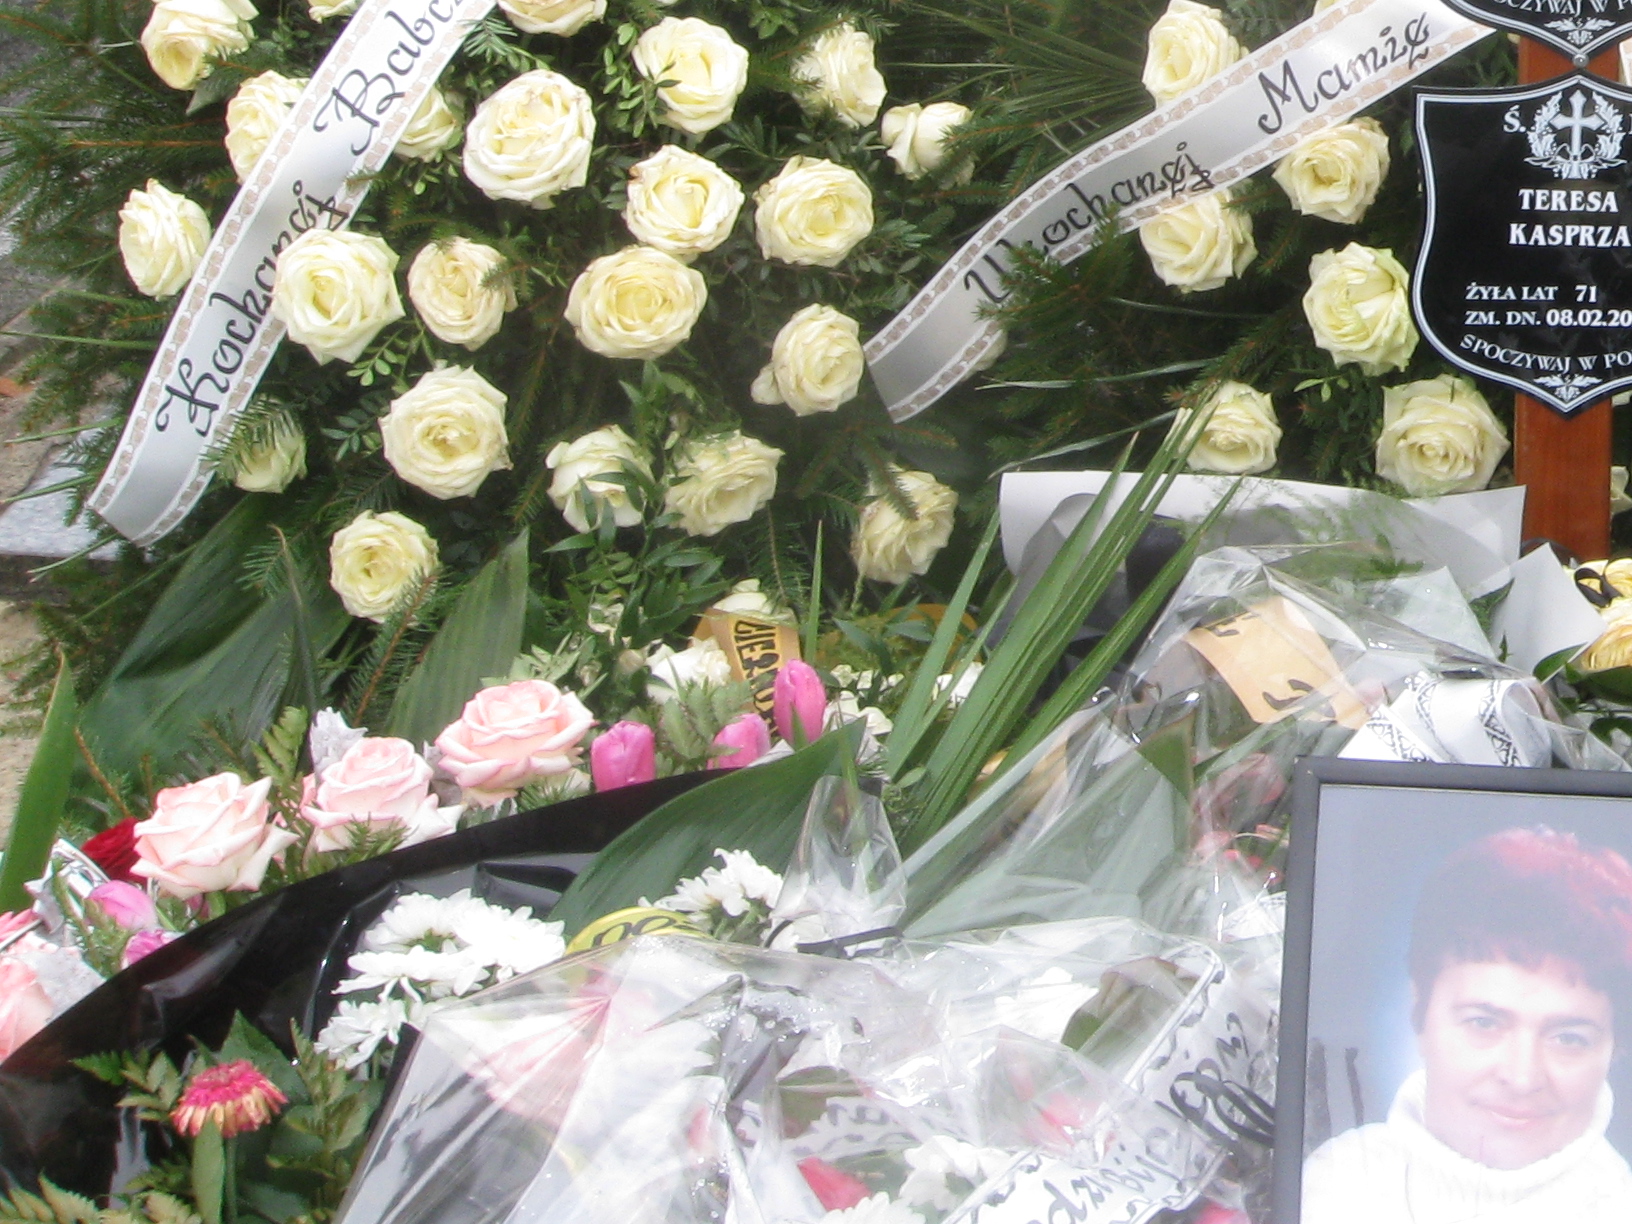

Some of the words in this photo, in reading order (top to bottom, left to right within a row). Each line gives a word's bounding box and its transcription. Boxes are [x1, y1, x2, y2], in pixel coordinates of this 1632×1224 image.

[1503, 104, 1526, 133] Ś.
[1518, 189, 1619, 213] TERESA
[1465, 281, 1516, 301] ŻYŁA
[1521, 285, 1559, 301] LAT
[1575, 285, 1598, 303] 71
[1464, 310, 1501, 326] ZM.
[1505, 311, 1541, 326] DN.
[1460, 333, 1571, 373] SPOCZYWAJ
[1577, 355, 1598, 371] W
